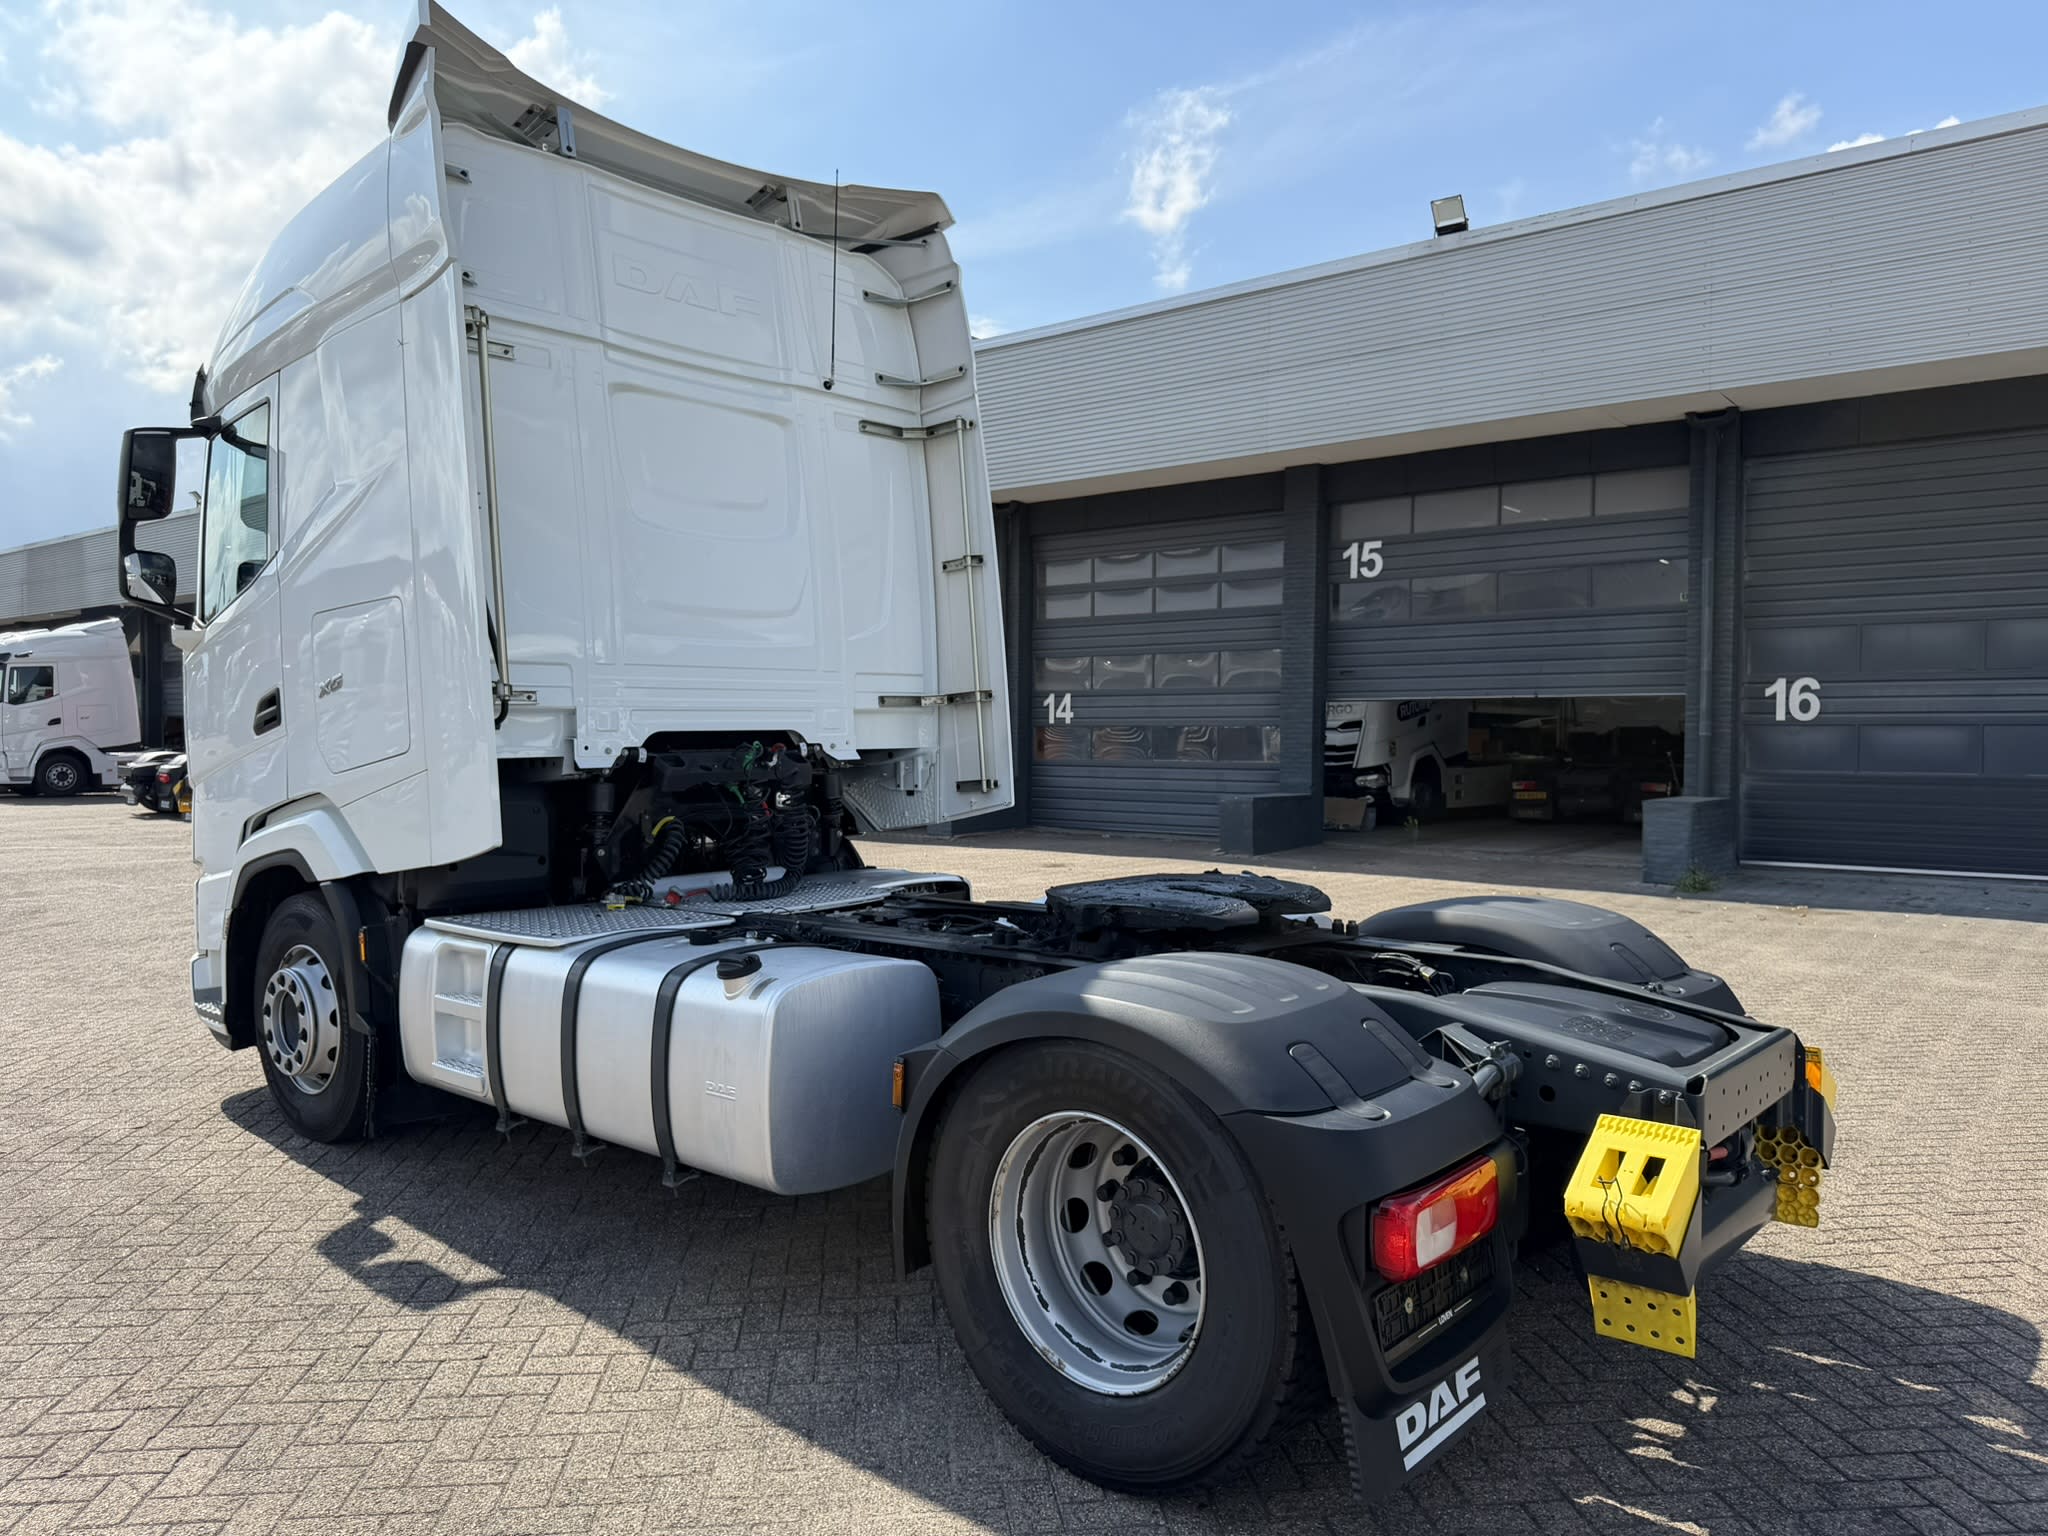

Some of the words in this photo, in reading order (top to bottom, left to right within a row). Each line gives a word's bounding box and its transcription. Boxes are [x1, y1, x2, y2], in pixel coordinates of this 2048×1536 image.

[613, 252, 760, 316] DAF
[1342, 540, 1384, 579] 15
[1043, 692, 1074, 724] 14
[1764, 677, 1821, 721] 16
[705, 1080, 736, 1096] DAF
[1395, 1356, 1481, 1451] DAF
